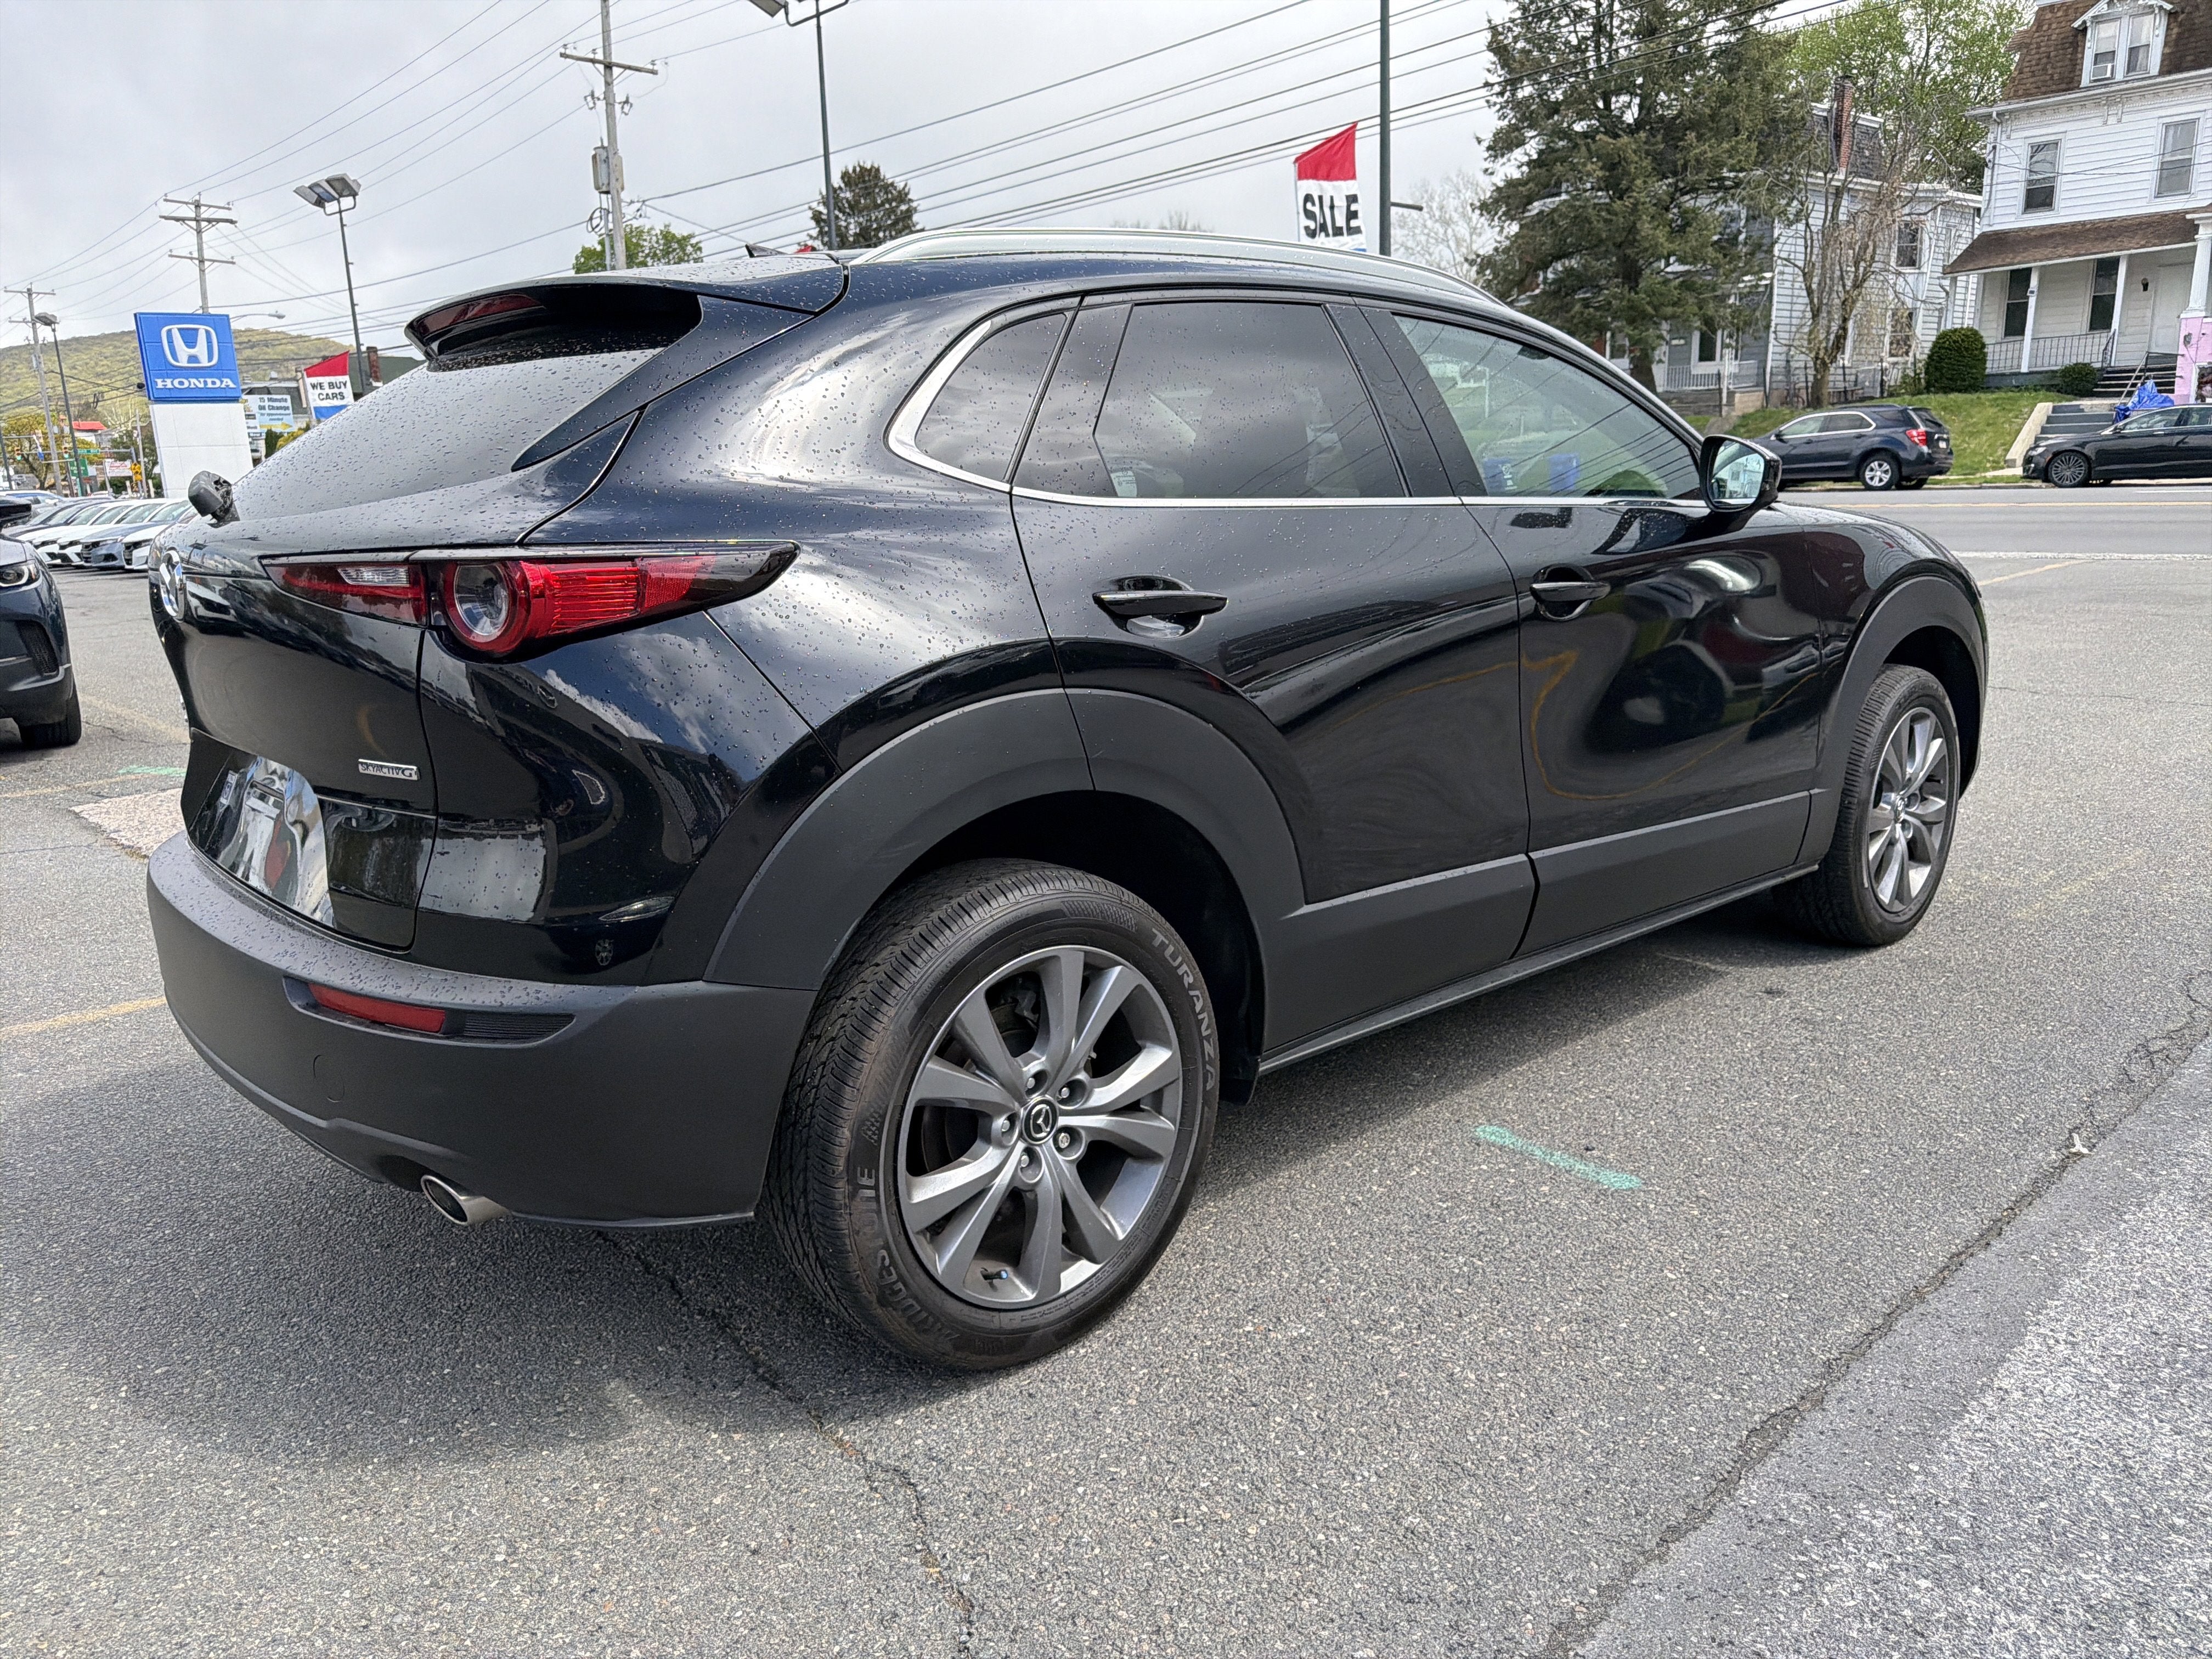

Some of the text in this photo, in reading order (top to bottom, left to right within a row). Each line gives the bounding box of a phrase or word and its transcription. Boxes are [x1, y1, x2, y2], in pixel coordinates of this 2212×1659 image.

[1302, 193, 1363, 239] SALE
[155, 378, 237, 389] HONDA
[310, 380, 348, 391] WE BUY
[318, 392, 346, 401] CARS
[1152, 928, 1215, 1091] TURANZA
